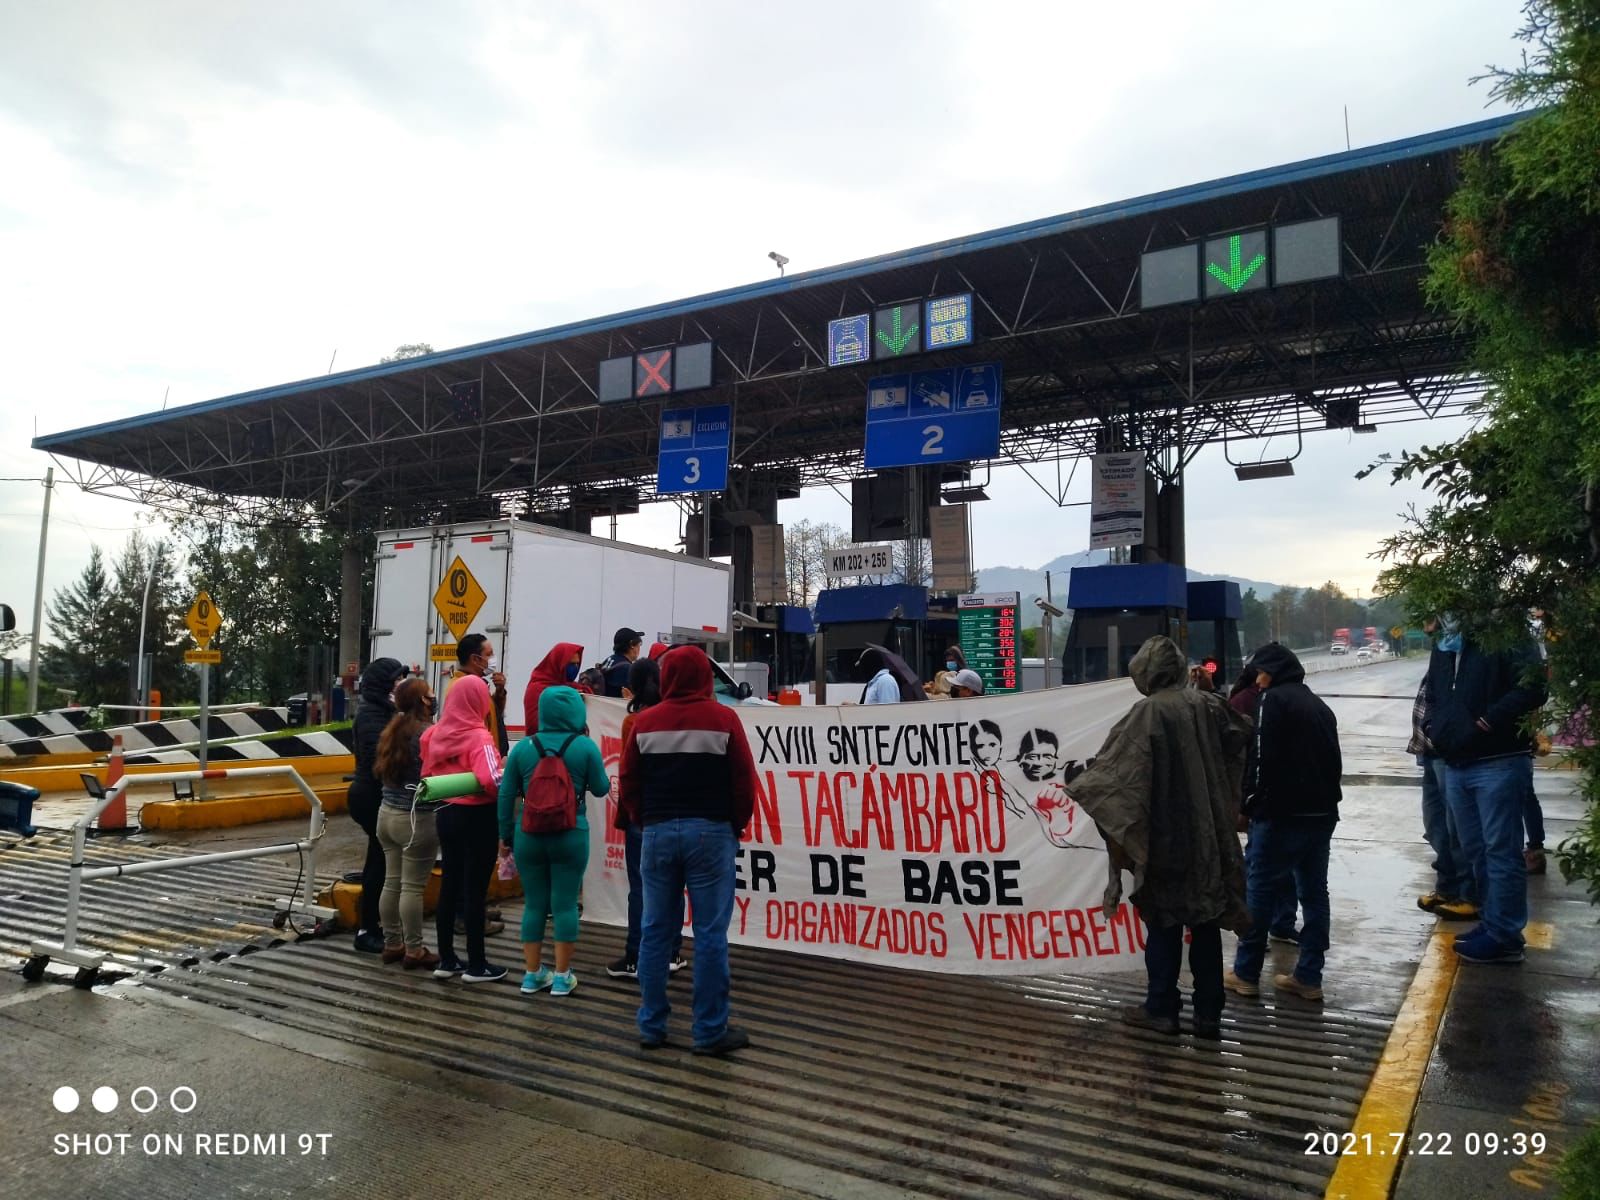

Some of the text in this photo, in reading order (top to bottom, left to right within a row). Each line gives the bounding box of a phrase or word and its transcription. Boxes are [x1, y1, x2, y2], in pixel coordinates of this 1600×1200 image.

[697, 421, 727, 433] EXCLUSIVO
[921, 425, 944, 455] 2
[683, 457, 700, 484] 3
[832, 556, 846, 572] KM
[848, 554, 862, 570] 202
[872, 552, 887, 568] 256
[449, 611, 468, 625] PICOS
[1001, 608, 1014, 617] 164
[999, 629, 1015, 637] 284
[999, 649, 1015, 657] 415
[1004, 659, 1016, 667] 82
[1005, 680, 1016, 688] 82
[755, 721, 971, 767] XVIII SNTE/CNTE
[787, 763, 1006, 854] TACÁMBARO
[810, 853, 867, 898] DE
[902, 859, 1024, 907] BASE
[766, 899, 947, 958] ORGANIZADOS
